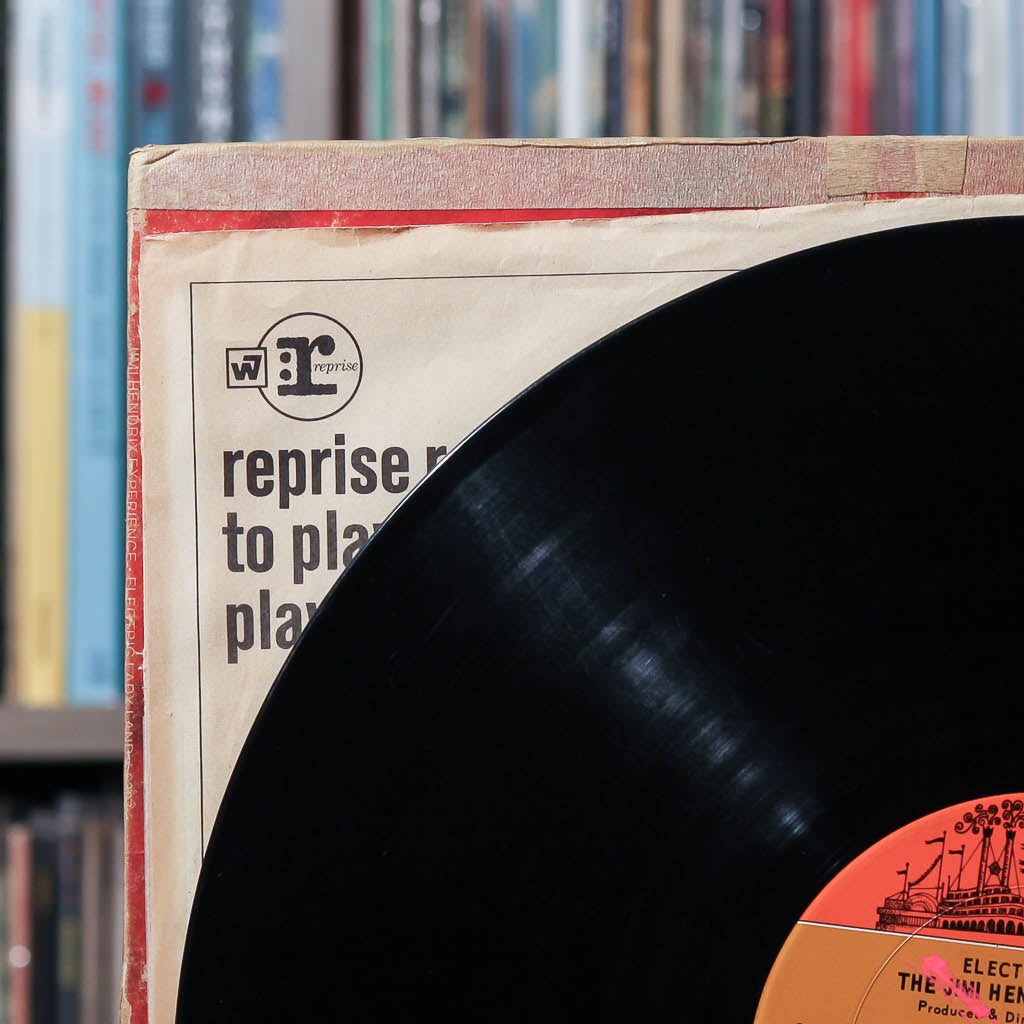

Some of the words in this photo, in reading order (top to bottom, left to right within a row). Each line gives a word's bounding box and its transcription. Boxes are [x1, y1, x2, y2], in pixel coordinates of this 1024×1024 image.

[312, 359, 359, 374] reprise
[127, 380, 140, 454] HENDRIX
[223, 433, 410, 509] reprise
[222, 512, 274, 573] to
[292, 509, 385, 585] pla
[226, 589, 319, 665] pla
[898, 972, 936, 994] THE
[988, 1008, 998, 1021] &
